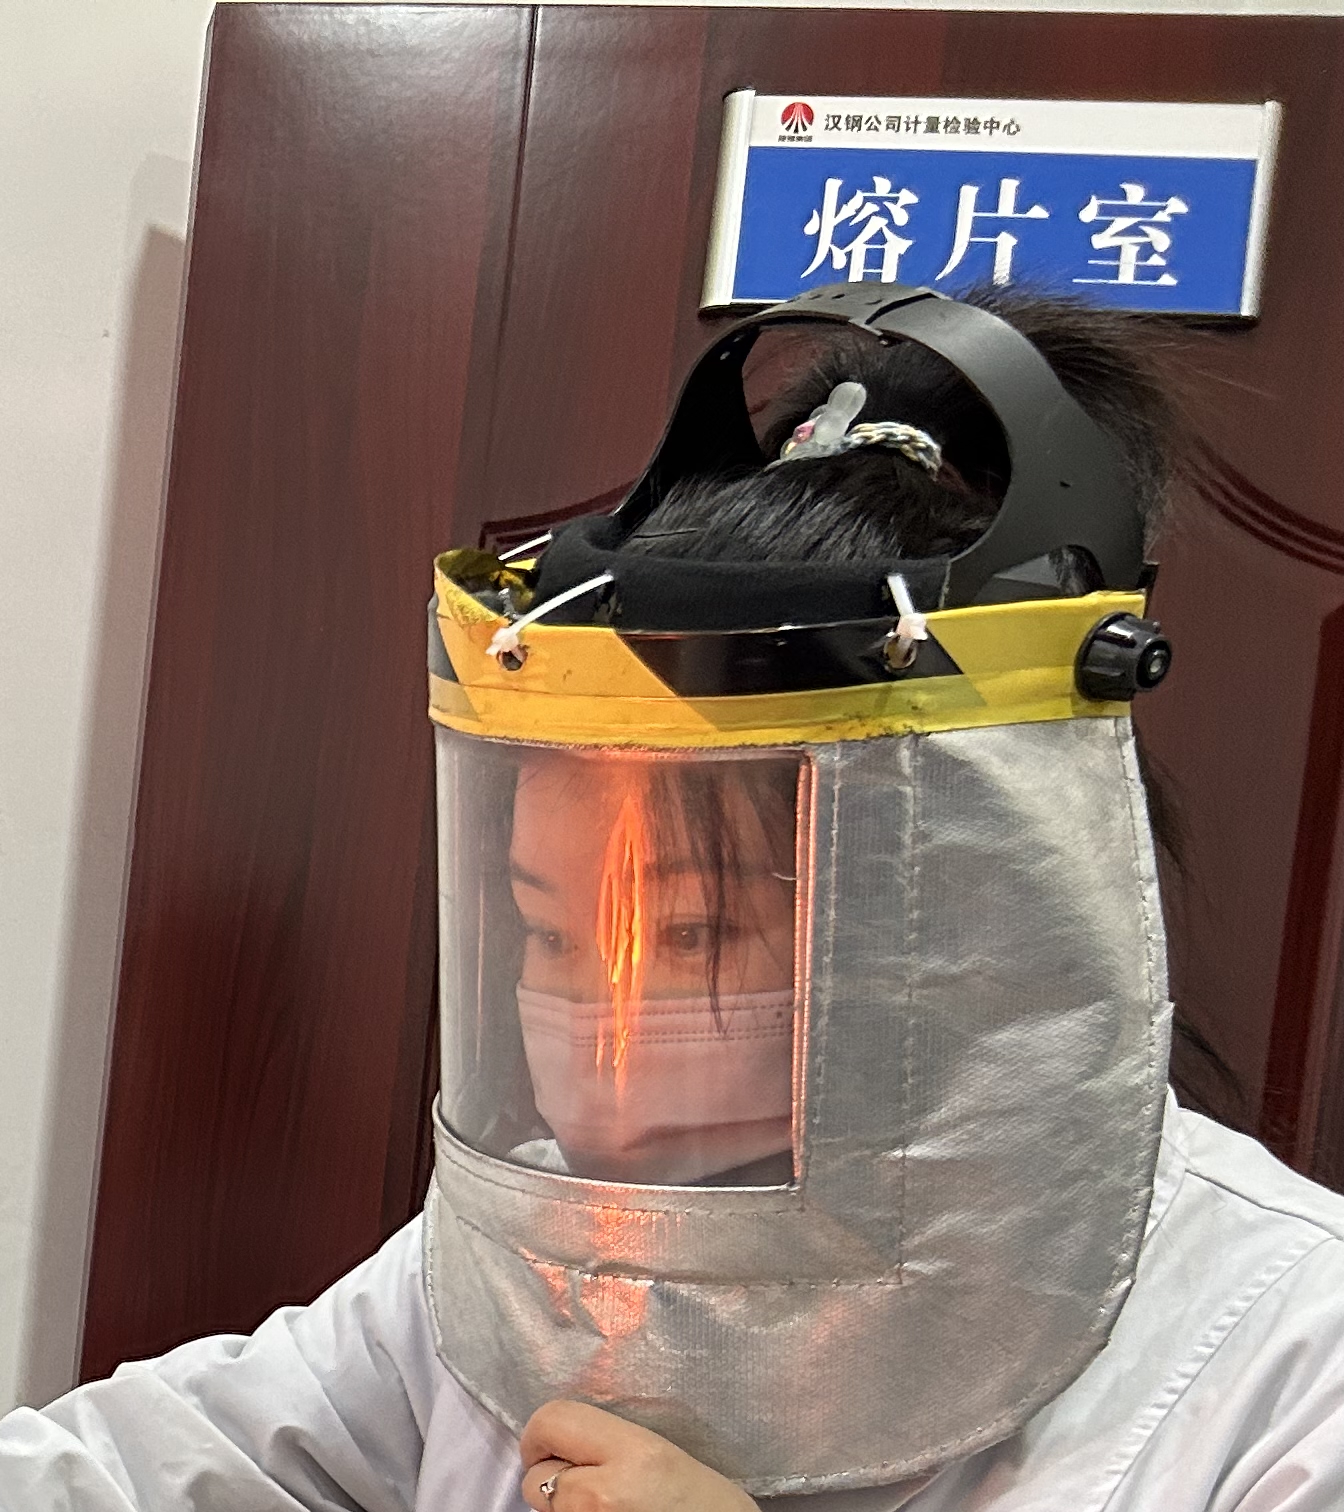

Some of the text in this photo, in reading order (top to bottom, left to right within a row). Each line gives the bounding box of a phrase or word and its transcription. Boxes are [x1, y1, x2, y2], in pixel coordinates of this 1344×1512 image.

[823, 113, 1021, 136] 汉钢公司计量检验中心
[800, 175, 1190, 287] 熔片室
